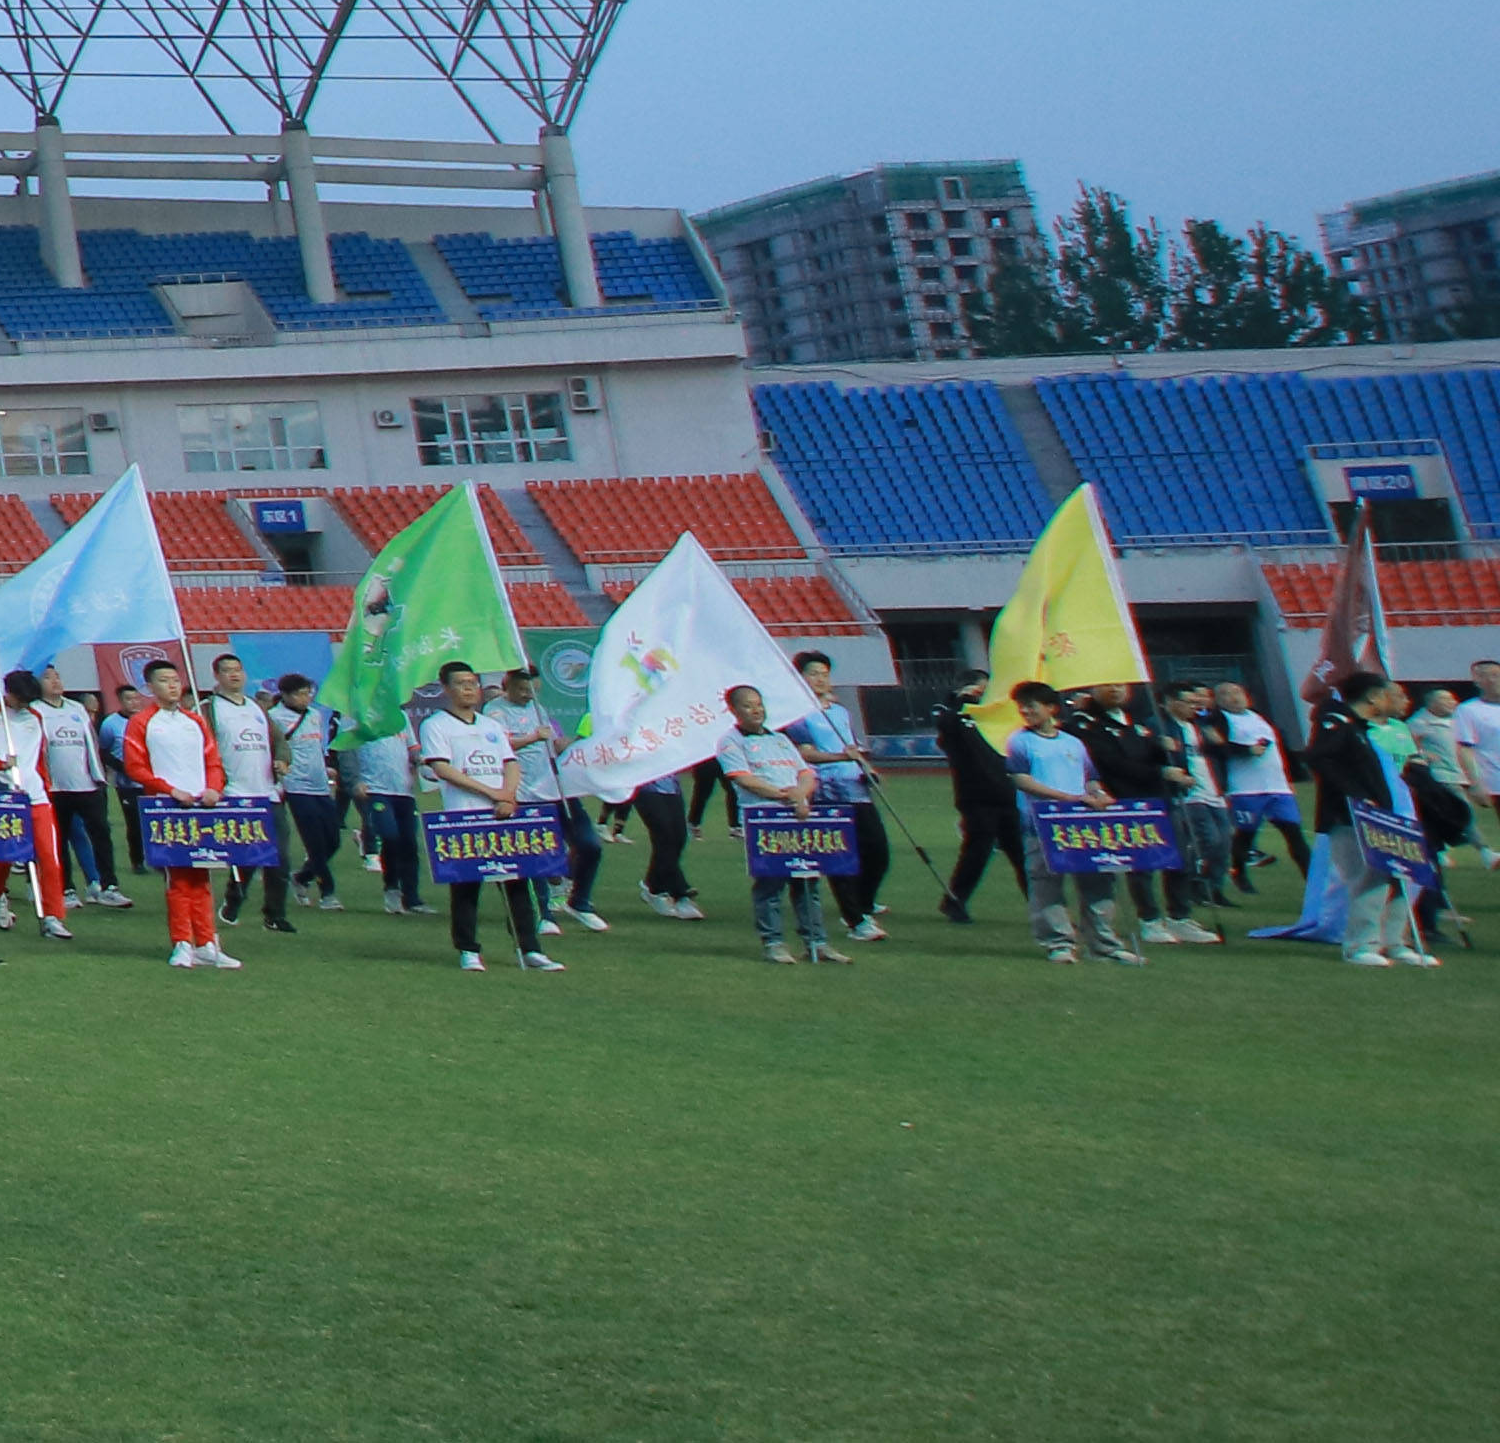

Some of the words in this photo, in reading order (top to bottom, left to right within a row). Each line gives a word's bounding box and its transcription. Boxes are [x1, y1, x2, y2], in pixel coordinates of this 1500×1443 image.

[149, 817, 269, 848] 兄弟连第一排足球队
